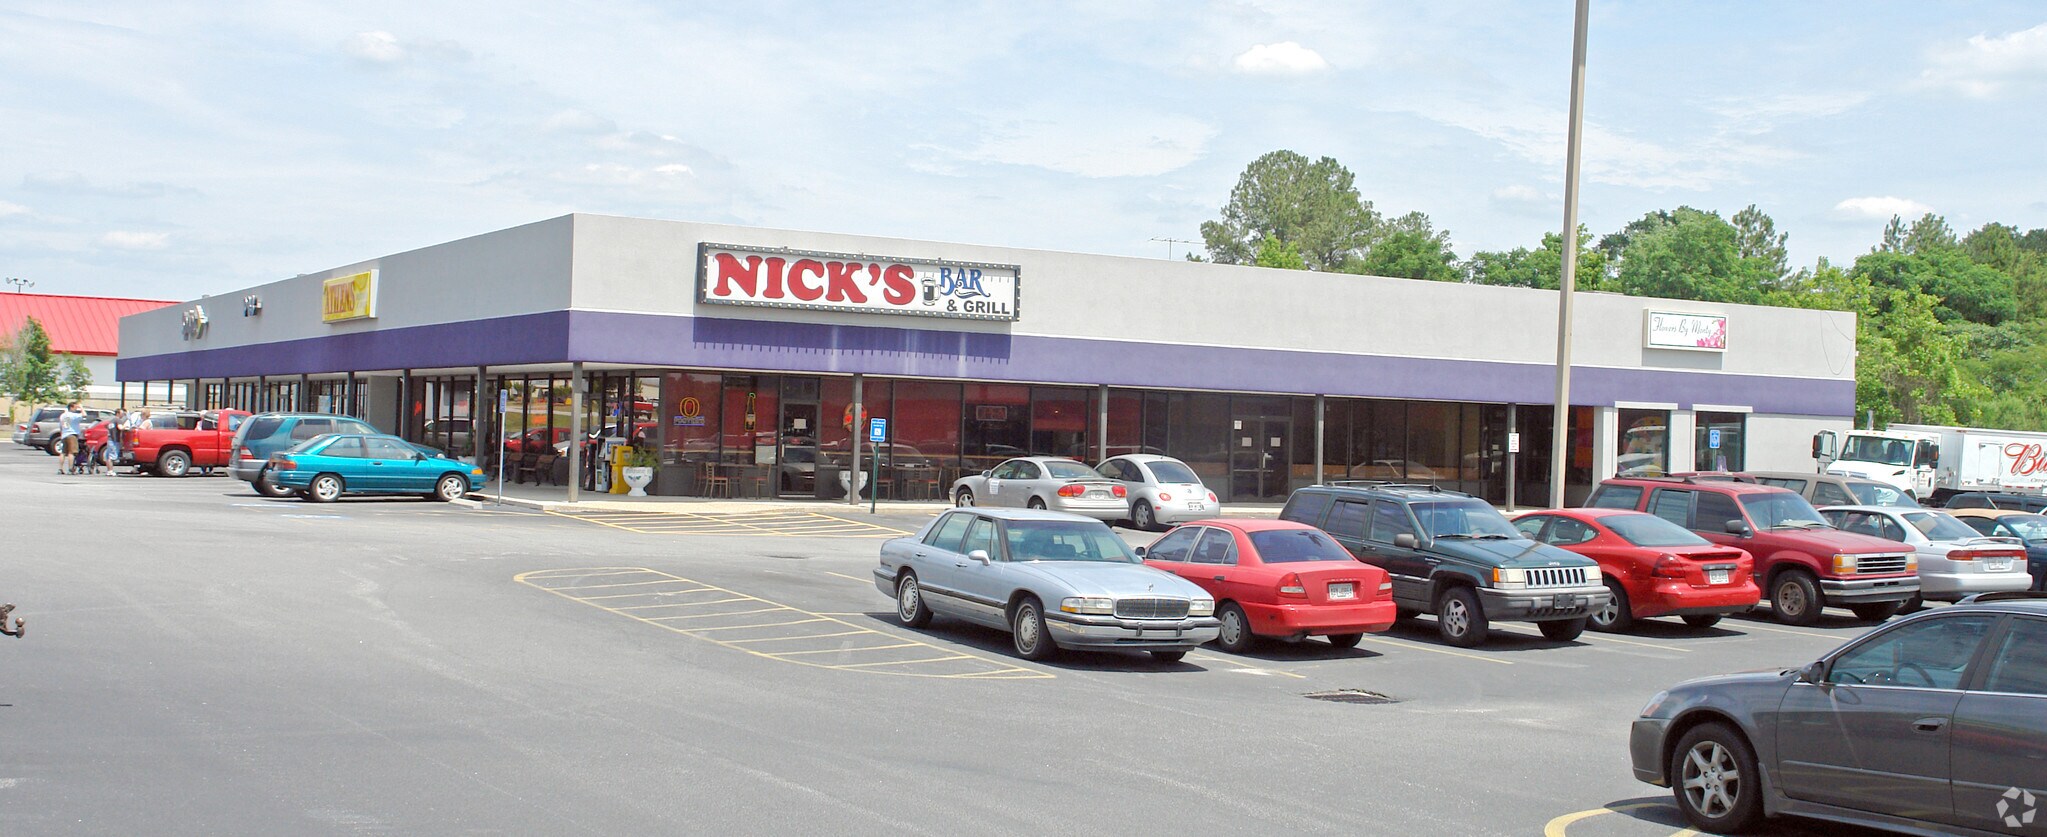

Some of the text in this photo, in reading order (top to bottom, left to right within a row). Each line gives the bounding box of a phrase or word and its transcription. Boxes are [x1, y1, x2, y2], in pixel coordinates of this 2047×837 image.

[713, 253, 991, 305] NICK'S BAR
[946, 299, 1010, 315] & GRILL
[1653, 317, 1677, 333] Flowers
[1679, 318, 1689, 336] By
